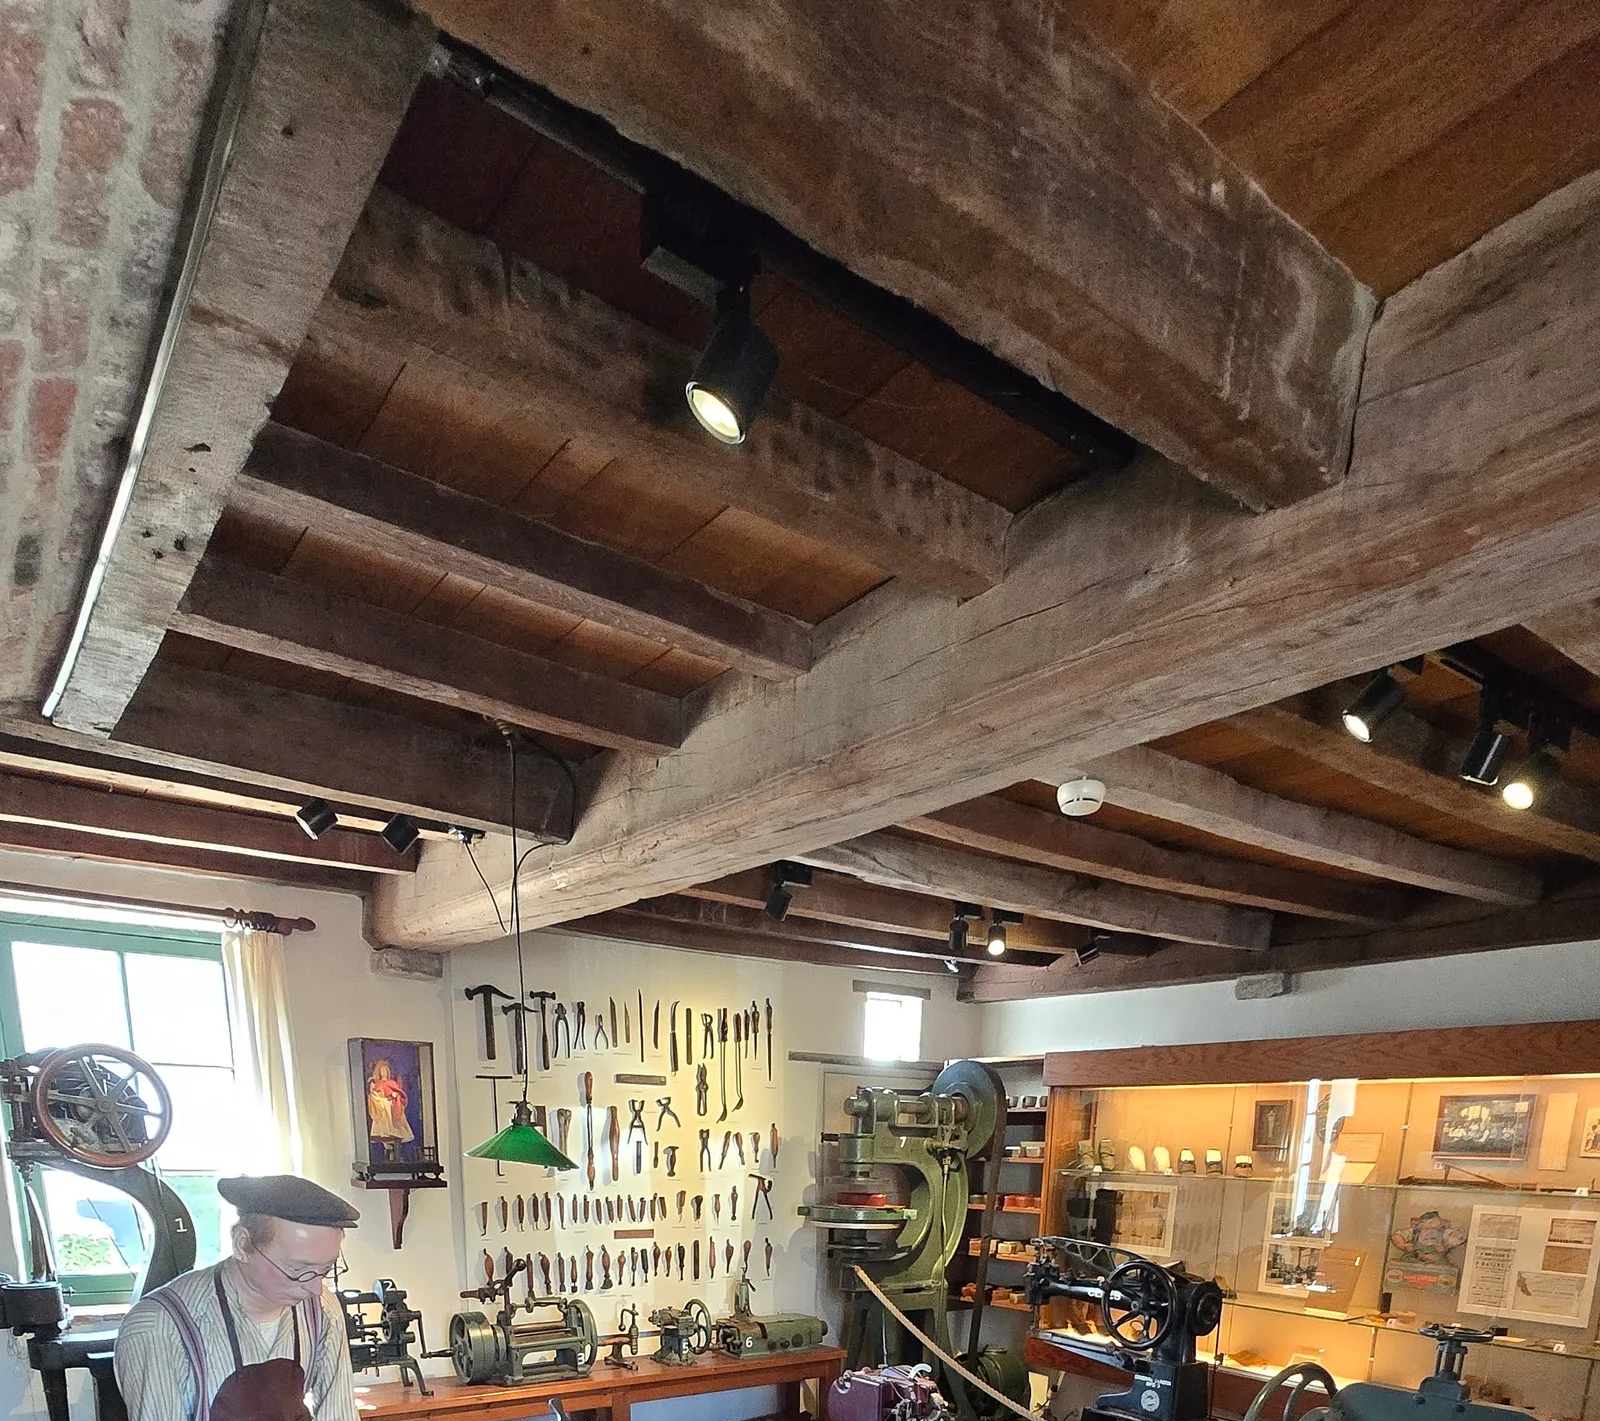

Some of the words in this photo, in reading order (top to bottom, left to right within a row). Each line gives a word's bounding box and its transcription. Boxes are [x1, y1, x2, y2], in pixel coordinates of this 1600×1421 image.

[899, 1136, 907, 1148] 7
[174, 1217, 188, 1233] 1
[383, 1280, 397, 1292] 2
[682, 1341, 690, 1354] 5
[745, 1336, 754, 1348] 6
[576, 1352, 586, 1366] 3
